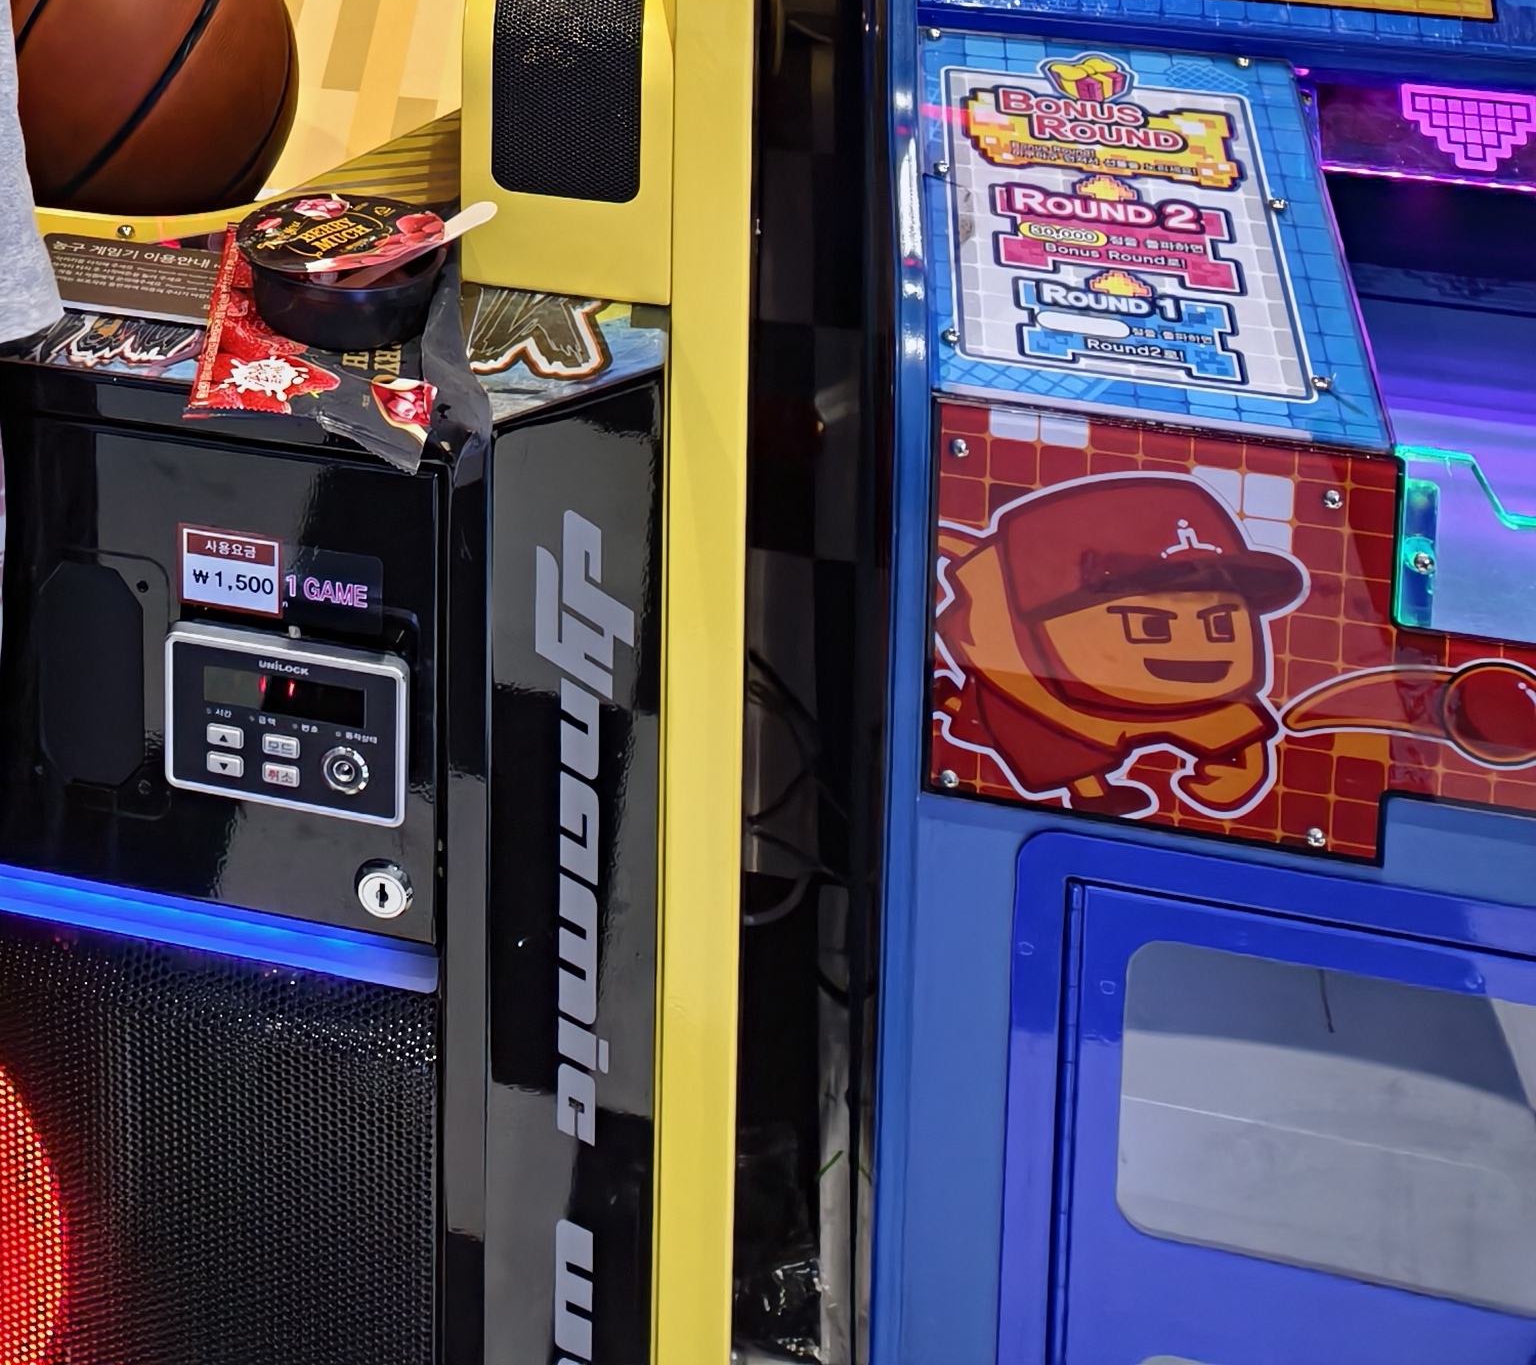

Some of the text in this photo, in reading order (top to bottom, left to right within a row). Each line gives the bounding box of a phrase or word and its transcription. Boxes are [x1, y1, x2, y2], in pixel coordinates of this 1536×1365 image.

[1001, 89, 1142, 125] BONUS
[1034, 114, 1181, 150] ROUND
[1014, 186, 1198, 230] ROUND 2
[297, 217, 358, 244] BERRY
[310, 224, 374, 253] MUCH
[52, 240, 212, 269] 농구 게임기 이용안내
[1043, 243, 1101, 259] Bonus
[1043, 285, 1177, 319] ROUND 1
[204, 539, 257, 559] 사용요금
[285, 574, 369, 609] 1 GAME
[534, 509, 635, 1147] dynamic
[554, 1218, 594, 1365] w
